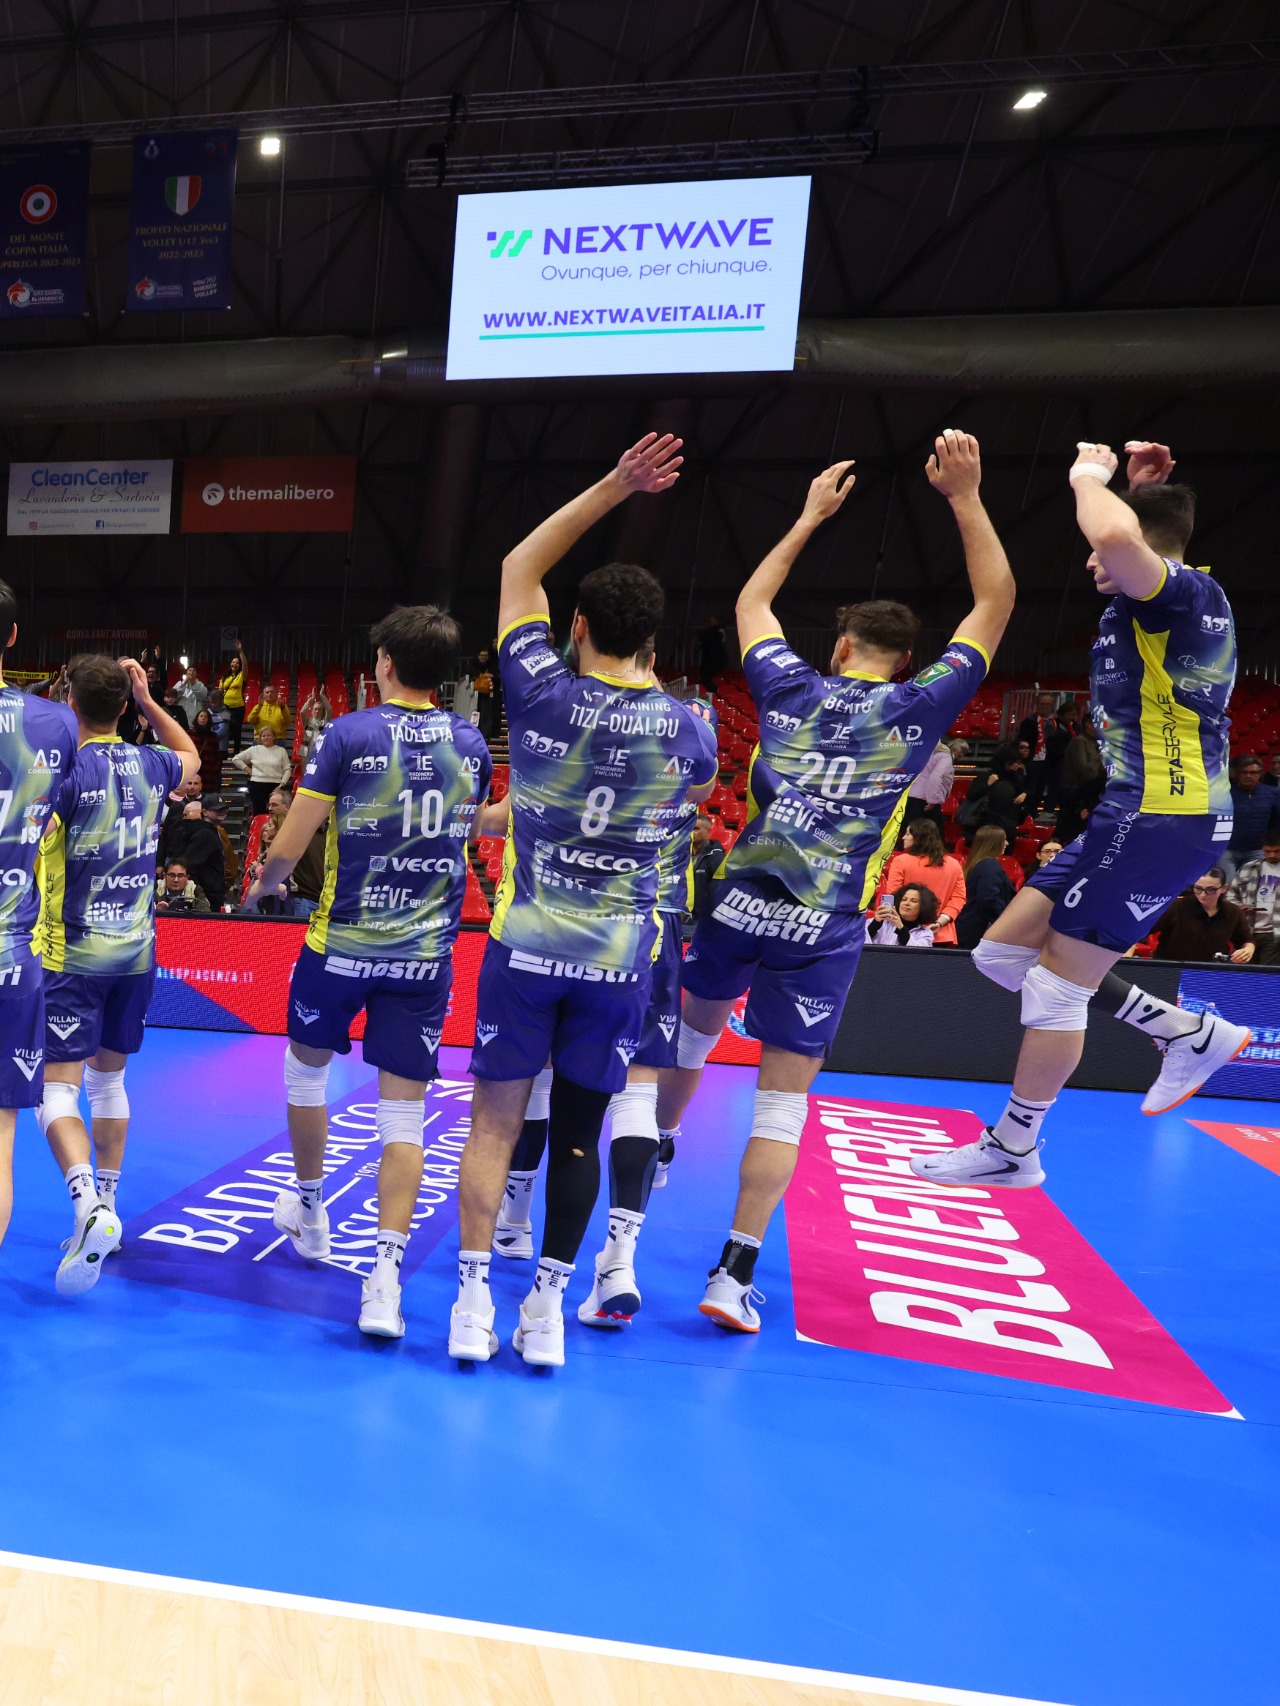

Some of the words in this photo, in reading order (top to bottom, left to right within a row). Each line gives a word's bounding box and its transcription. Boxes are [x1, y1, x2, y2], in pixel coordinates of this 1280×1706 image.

[10, 233, 26, 244] DEL
[30, 231, 65, 242] MONTE
[135, 226, 171, 235] TROFEO
[173, 223, 228, 233] NAZIONALE
[543, 218, 774, 255] NEXTWAVE
[5, 246, 36, 256] COPPA
[39, 244, 69, 254] ITALIA
[142, 238, 176, 248] VOLLEY
[541, 264, 633, 282] Ovunque,
[639, 262, 672, 280] per
[677, 258, 772, 275] chiunque.
[483, 304, 766, 329] WWW.NEXTWAVEITALIA.IT
[31, 468, 149, 487] CleanCenter
[18, 487, 85, 504] Lavanderia
[90, 487, 107, 503] &
[110, 485, 160, 502] Sartoria
[228, 484, 334, 501] themalibero
[606, 694, 672, 712] W.TRAINING
[824, 695, 874, 714] BENTO
[569, 704, 680, 739] TIZI-OUALOU
[795, 751, 857, 799] 20
[398, 789, 444, 839] 10
[580, 786, 616, 837] 8
[794, 799, 824, 832] VF
[346, 817, 379, 832] CR
[448, 822, 472, 838] USC
[114, 815, 143, 859] 11
[813, 828, 844, 848] GROUP
[559, 847, 640, 873] VECA
[748, 834, 852, 875] CENTROLMER
[391, 857, 456, 873] VECA
[107, 873, 149, 890] VECA
[1064, 877, 1089, 909] 6
[1129, 893, 1172, 903] VILLANI
[723, 887, 832, 928] modena
[157, 967, 253, 983] ALESPIACENZA.IT
[354, 961, 441, 981] nastri
[797, 995, 835, 1012] VILLANI
[47, 1016, 81, 1024] VILLANI
[524, 1177, 534, 1192] nine
[623, 1219, 637, 1235] nine
[816, 1100, 1115, 1370] BLUENERGY
[384, 1240, 396, 1259] nine
[468, 1260, 478, 1278] nine
[549, 1269, 563, 1288] nine
